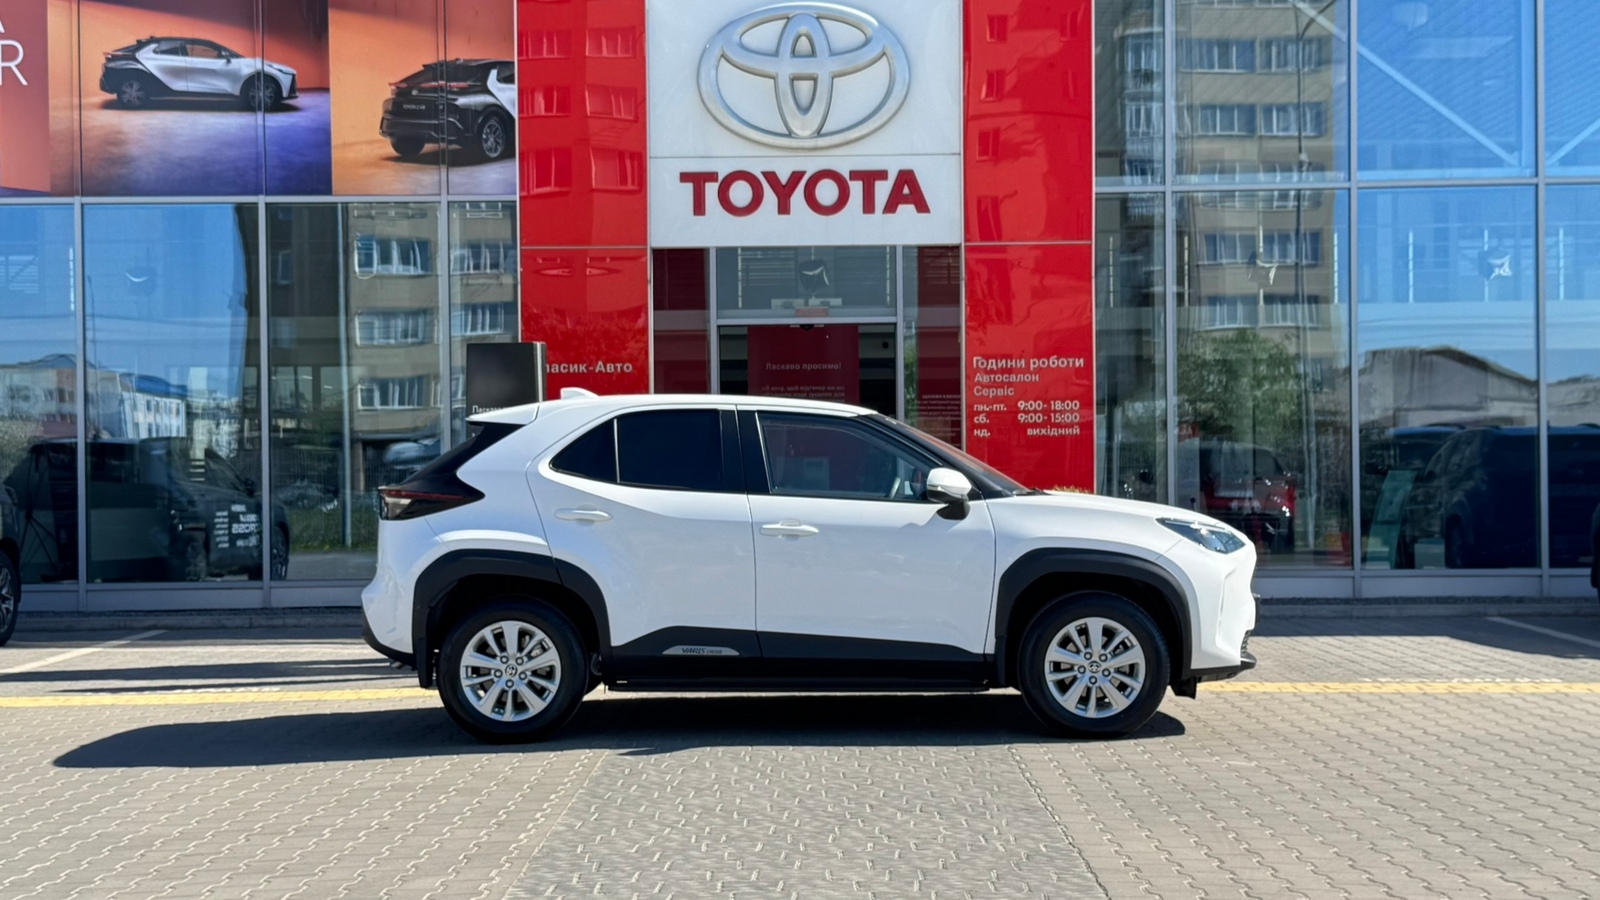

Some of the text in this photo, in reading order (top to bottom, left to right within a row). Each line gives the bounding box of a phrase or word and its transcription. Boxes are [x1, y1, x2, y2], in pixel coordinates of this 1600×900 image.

[679, 169, 931, 217] TOYOTA
[765, 362, 842, 371] Ласкаво просимо!
[973, 355, 1084, 371] Години роботи
[974, 373, 1039, 382] Автосалон
[974, 385, 1015, 398] Сервіс
[973, 413, 990, 423] сб.
[973, 425, 1080, 437] нд. вихідний
